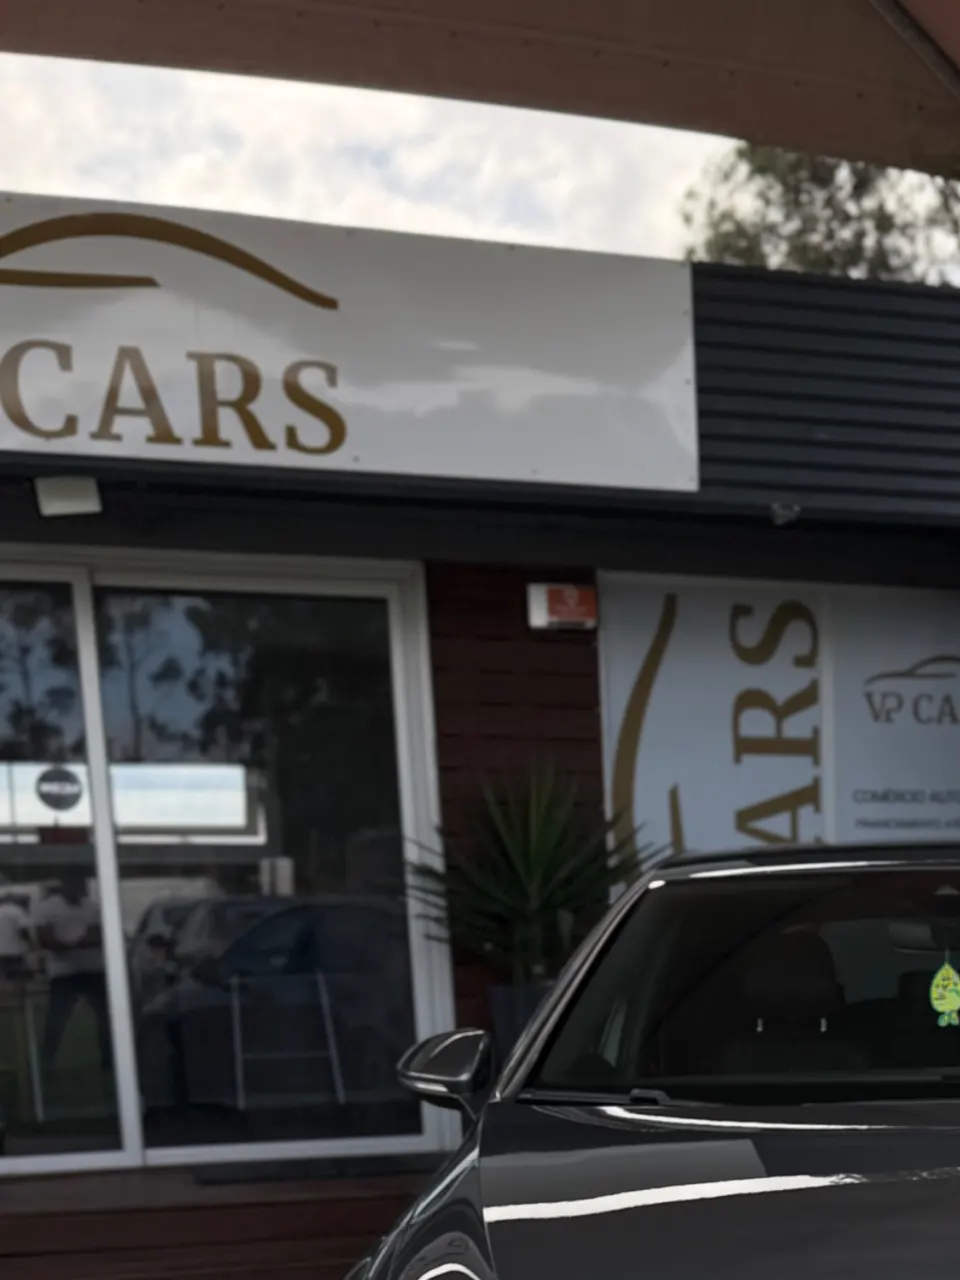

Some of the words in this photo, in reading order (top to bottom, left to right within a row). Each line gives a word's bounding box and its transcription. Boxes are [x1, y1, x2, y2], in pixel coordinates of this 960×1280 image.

[0, 338, 348, 456] CARS
[729, 599, 821, 846] ARS
[863, 691, 905, 724] VP
